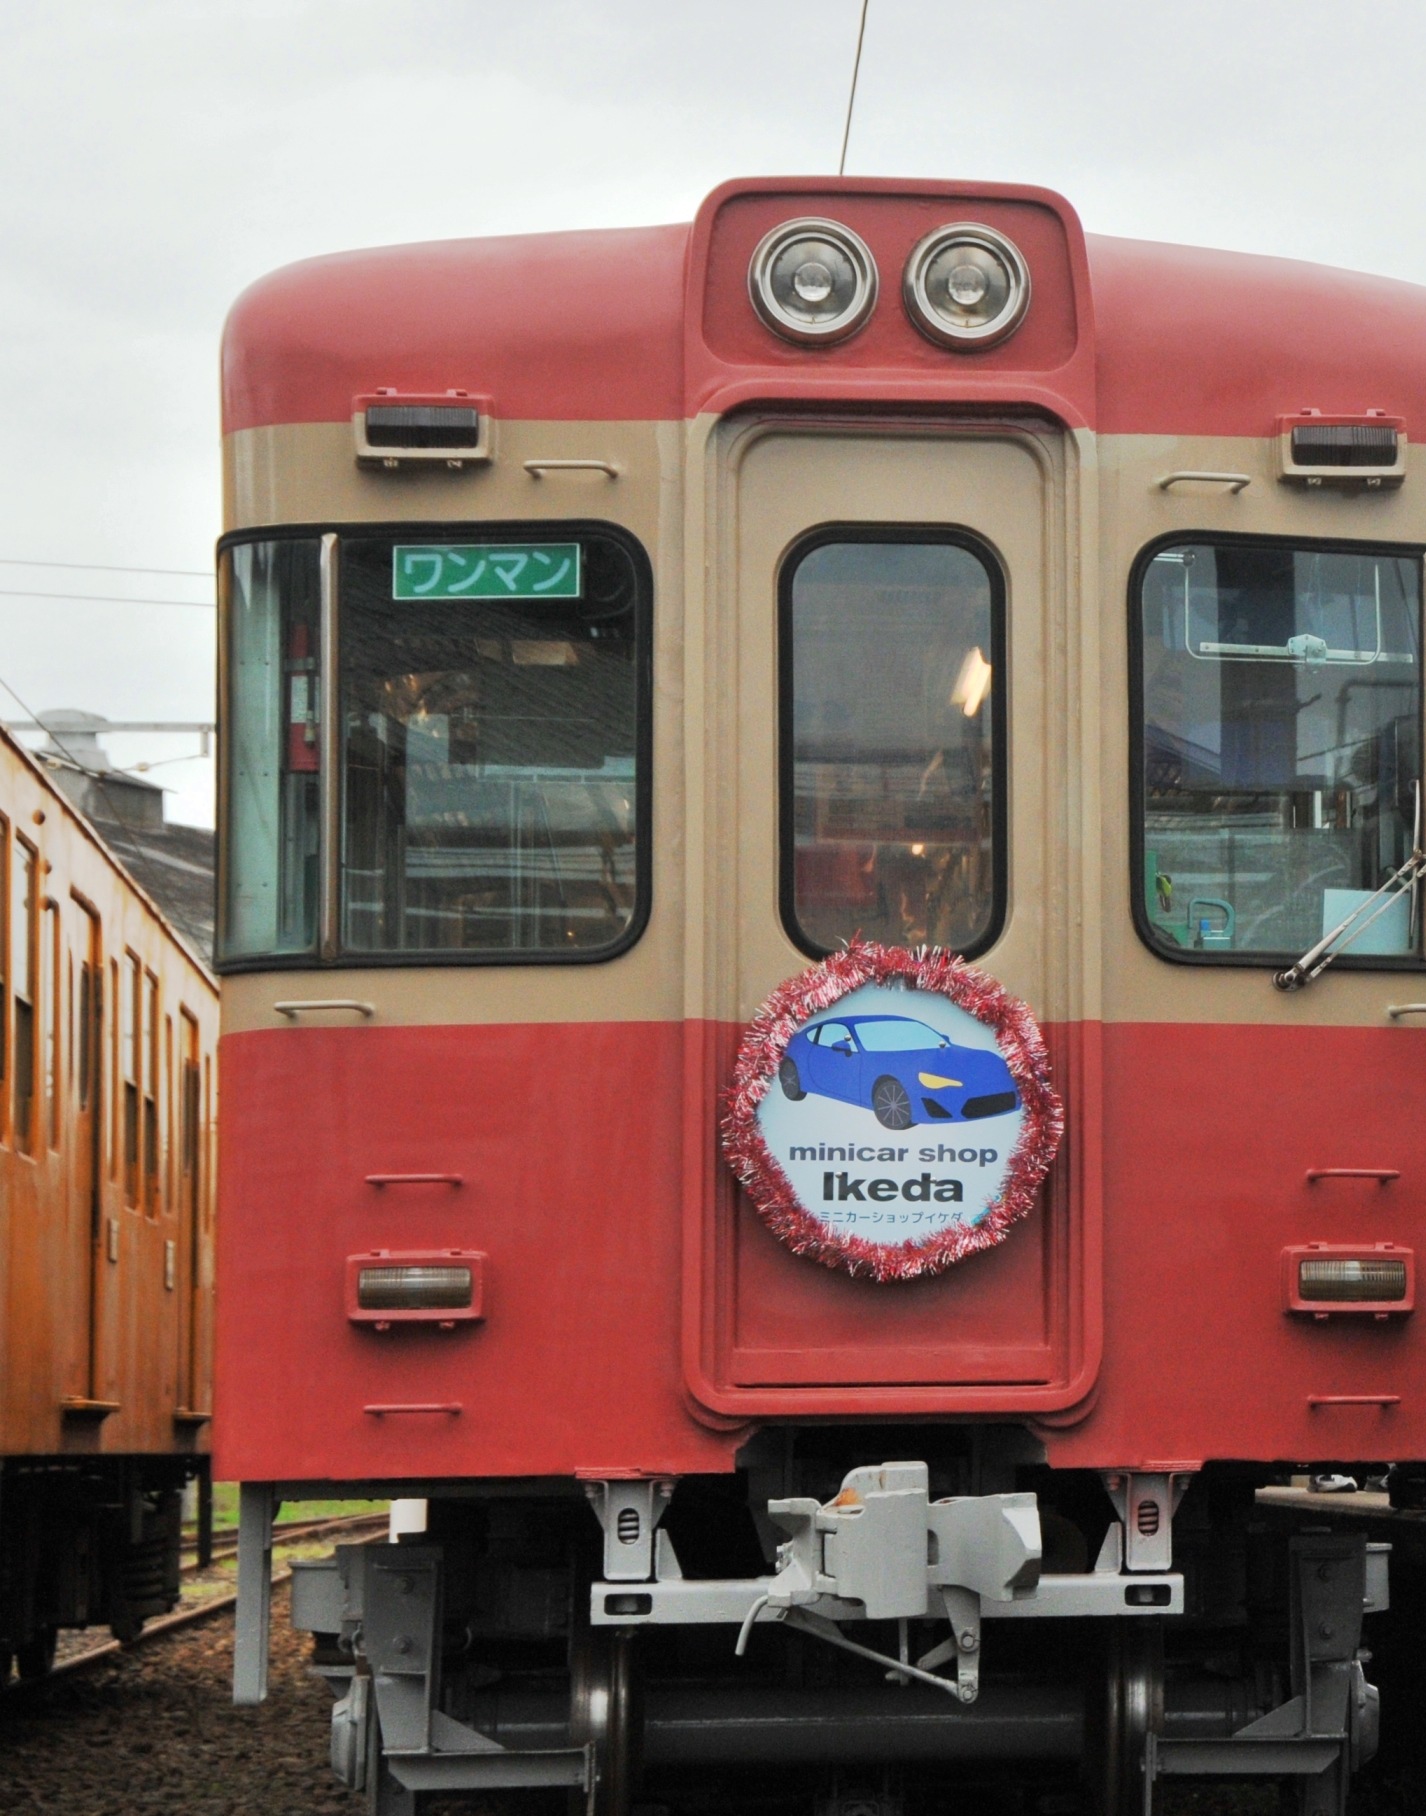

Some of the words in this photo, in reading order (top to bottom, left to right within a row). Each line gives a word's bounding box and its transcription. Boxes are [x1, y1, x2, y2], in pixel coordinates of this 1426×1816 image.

[404, 552, 570, 593] ワンマン
[789, 1143, 909, 1162] minicar
[918, 1144, 999, 1168] shop
[823, 1171, 964, 1203] Ikeda
[820, 1211, 964, 1224] ミニカーショップイケダ
